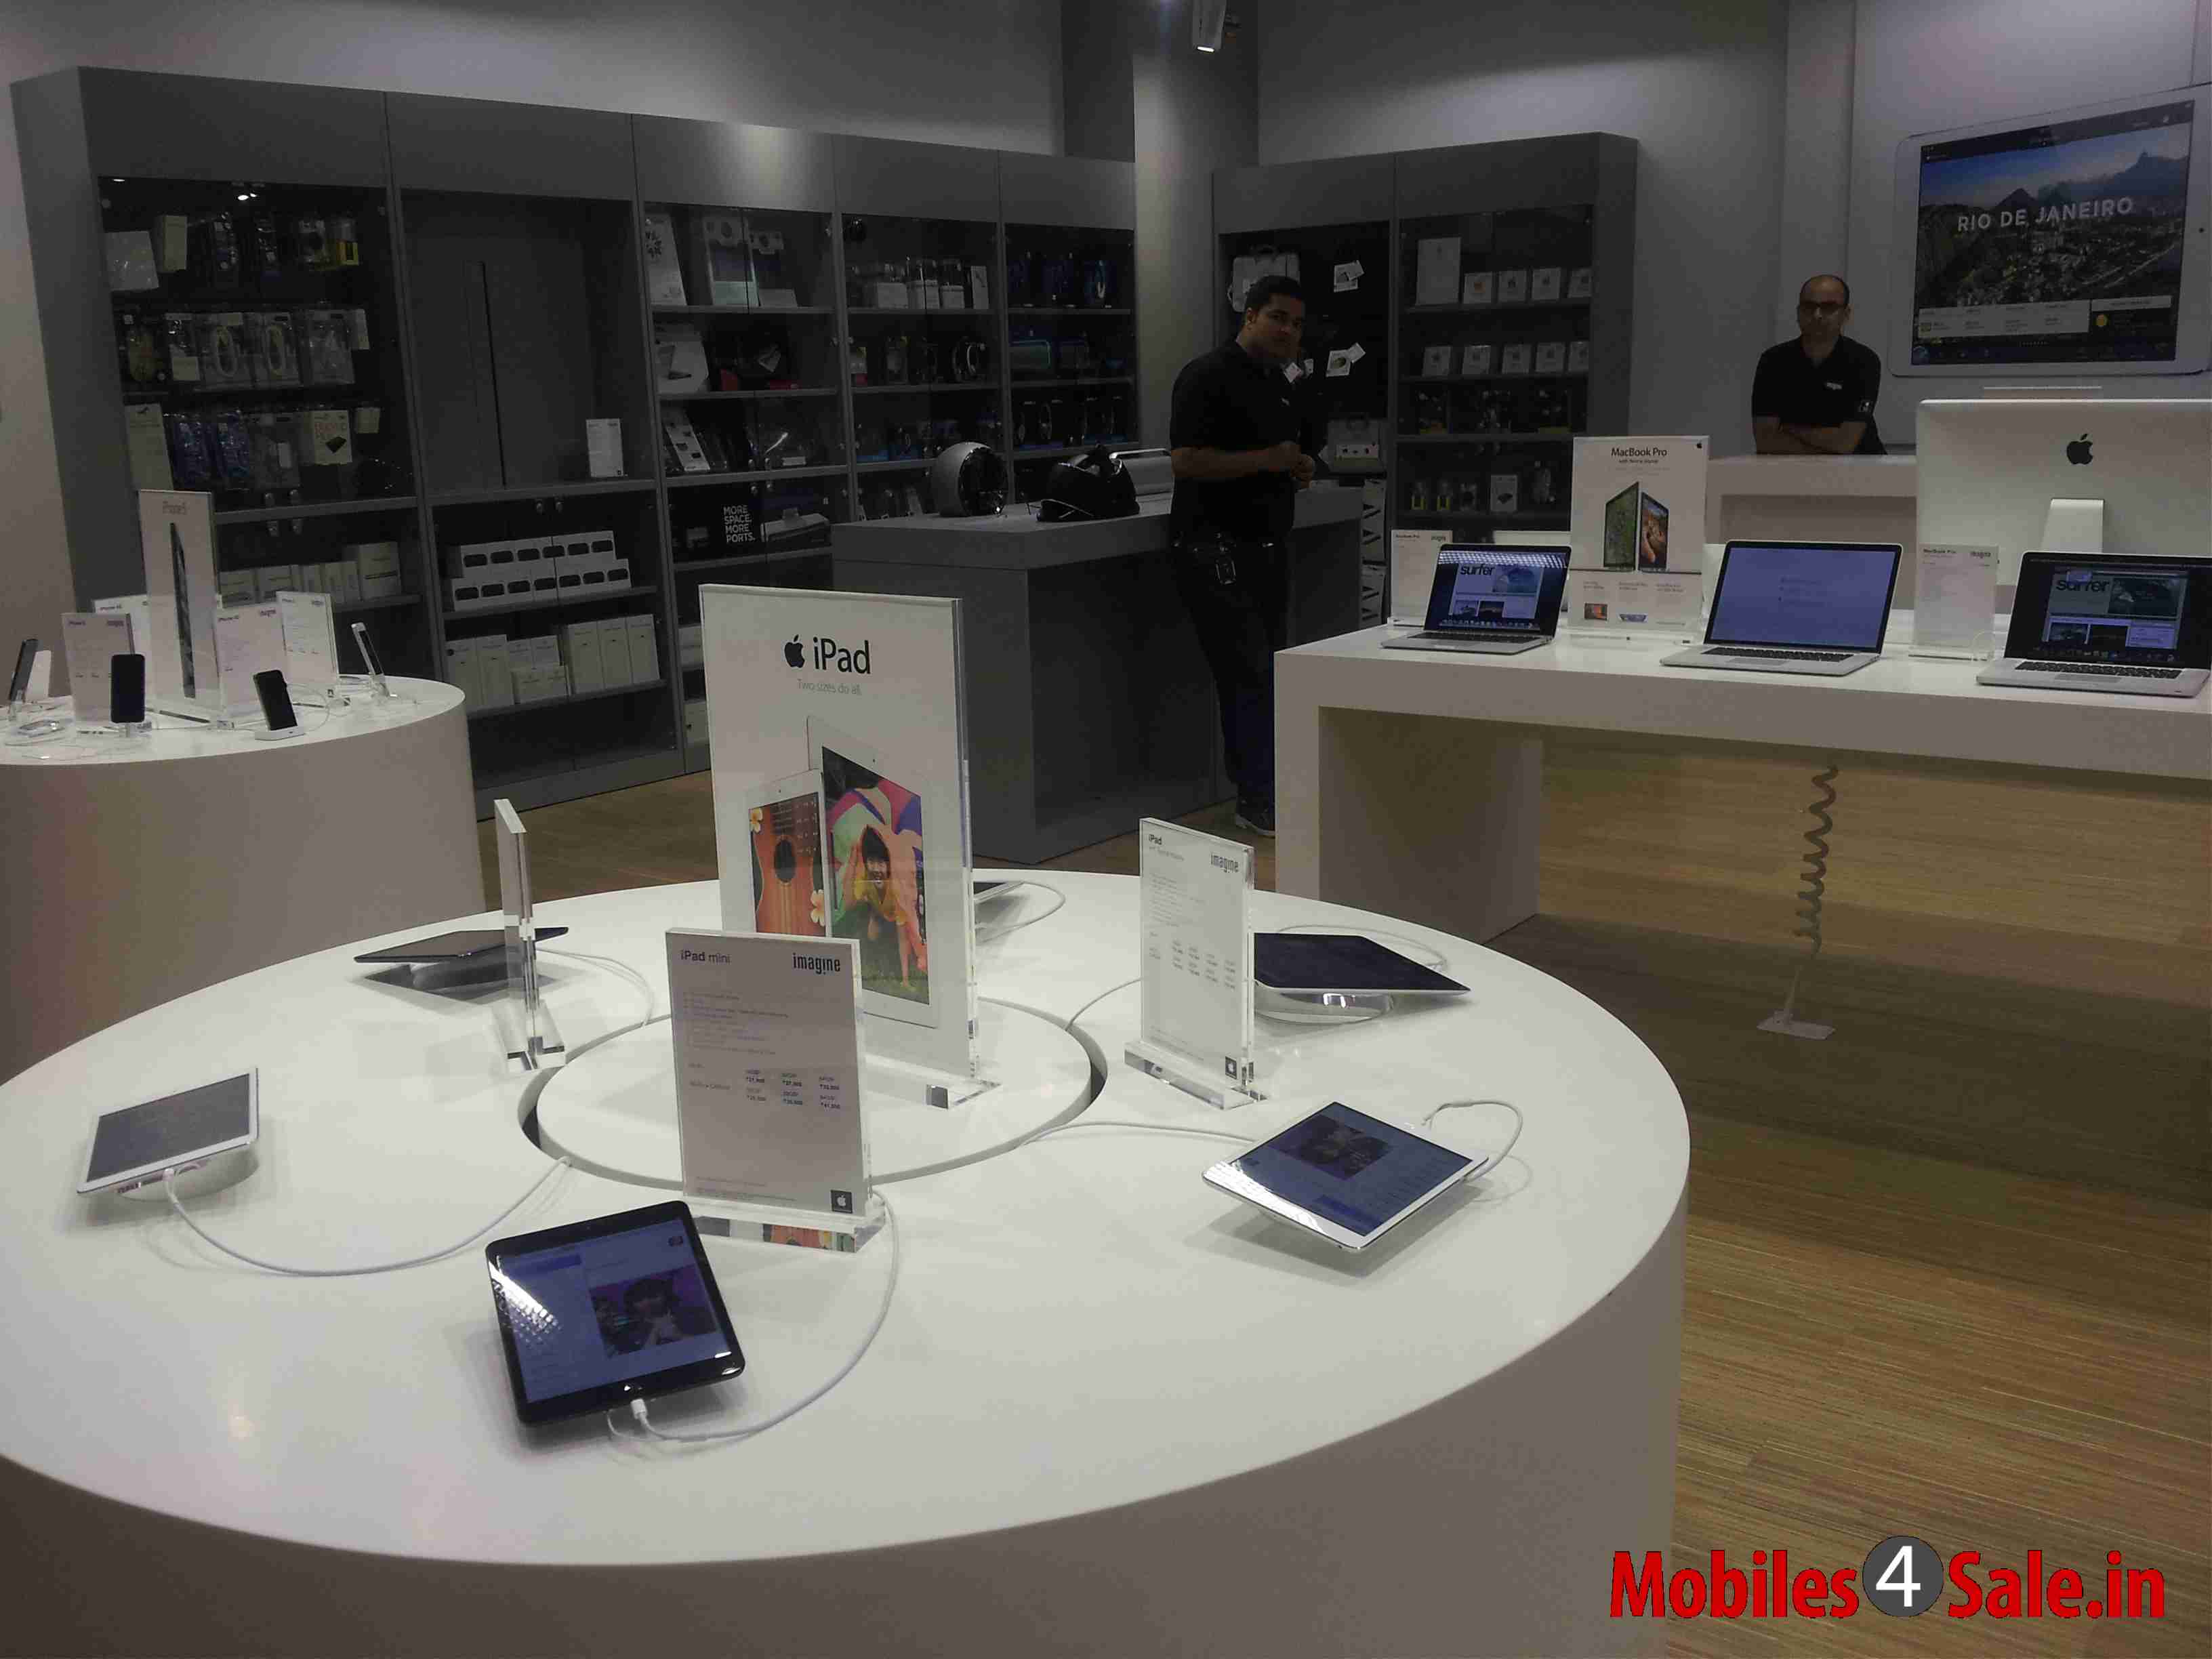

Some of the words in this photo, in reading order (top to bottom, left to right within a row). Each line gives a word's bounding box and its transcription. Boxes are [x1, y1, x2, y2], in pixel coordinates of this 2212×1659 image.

[1957, 213, 1992, 232] RIO
[2000, 209, 2027, 228] DE
[2035, 197, 2133, 224] JANEIRO
[1611, 447, 1651, 457] MacBook
[1653, 447, 1668, 456] Pro
[723, 505, 749, 515] MORE
[726, 524, 750, 533] MORE
[726, 532, 756, 543] PORTS.
[1460, 563, 1496, 575] surfer
[813, 636, 871, 674] iPad
[680, 949, 705, 962] iPad
[708, 952, 731, 964] mini
[792, 952, 841, 975] imagine
